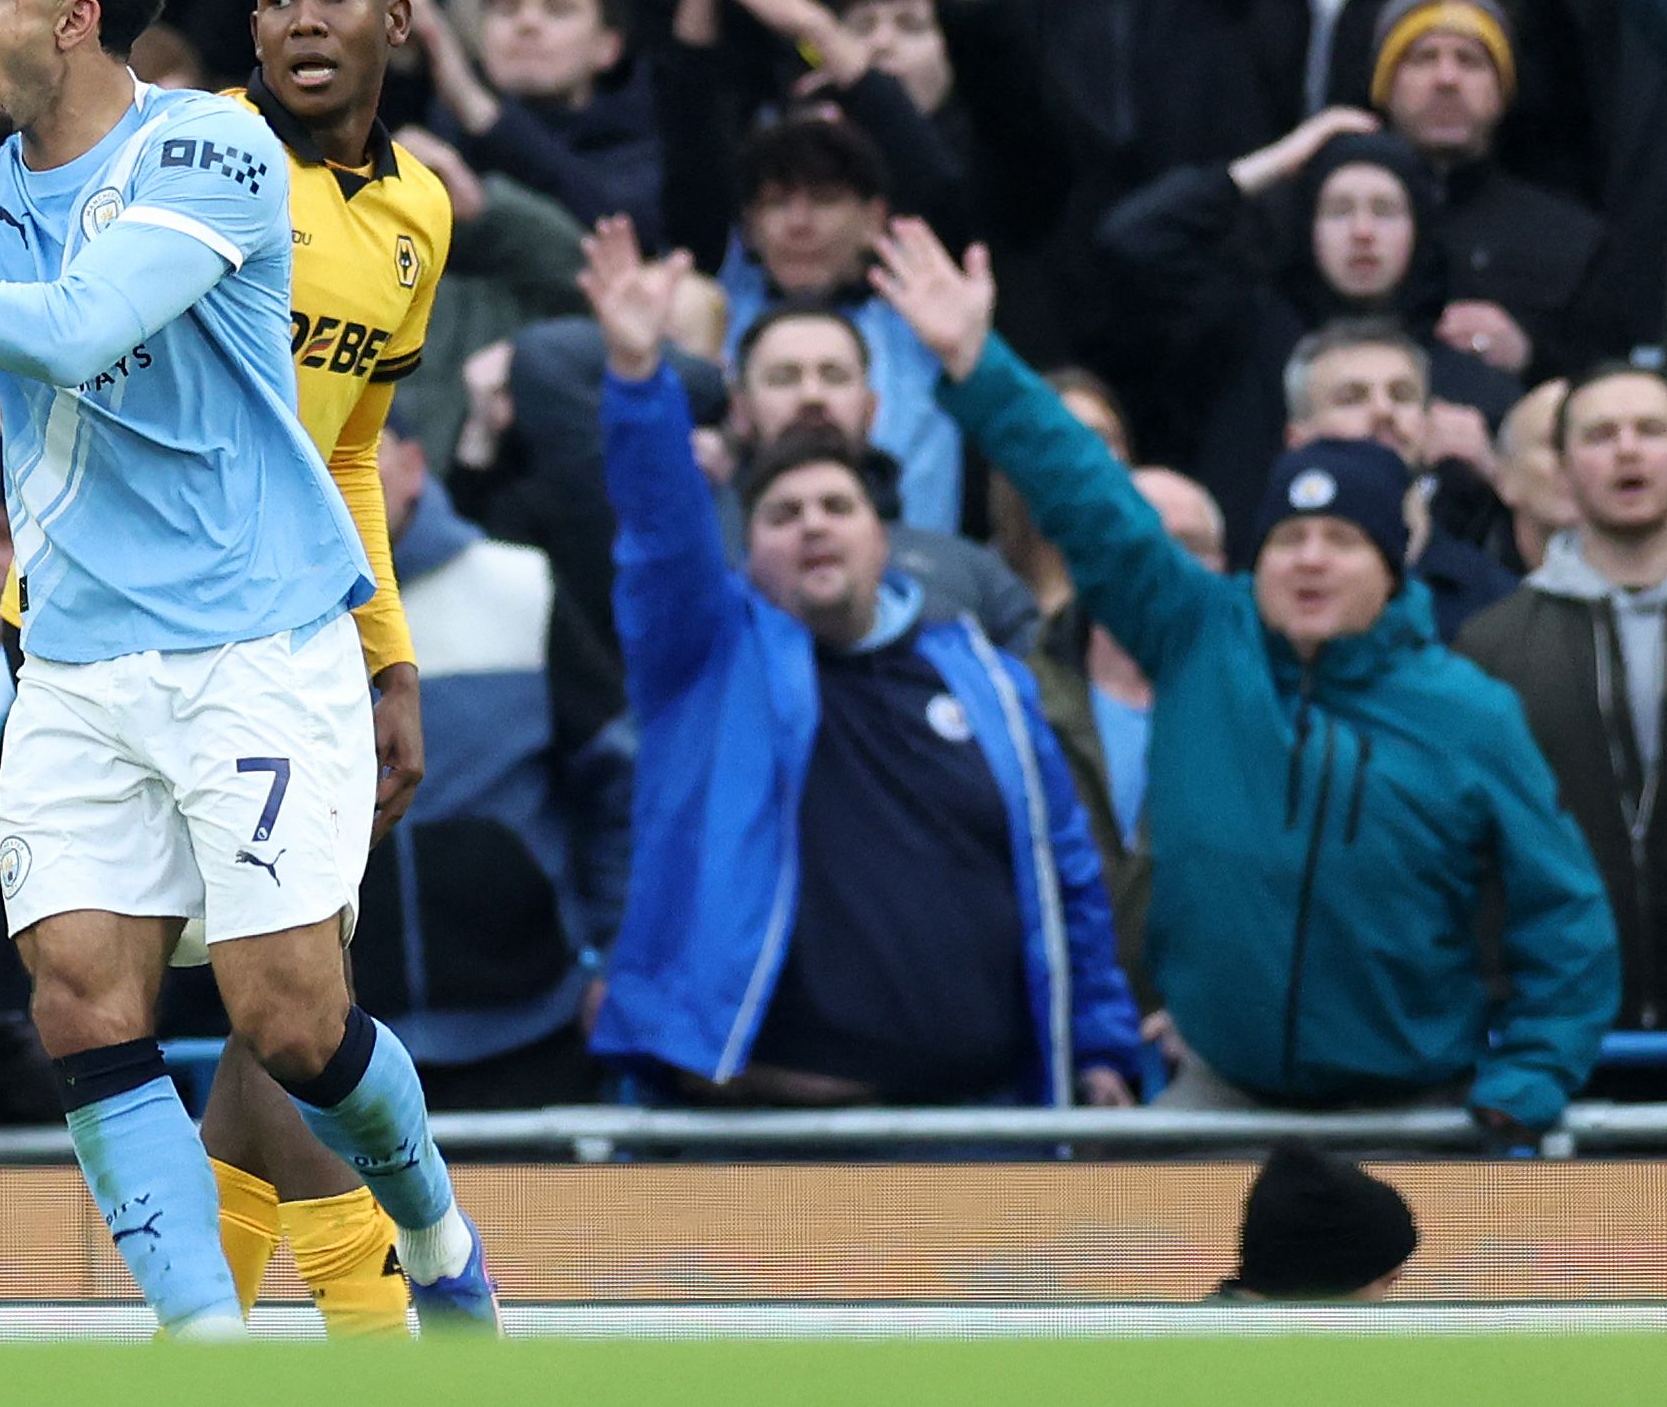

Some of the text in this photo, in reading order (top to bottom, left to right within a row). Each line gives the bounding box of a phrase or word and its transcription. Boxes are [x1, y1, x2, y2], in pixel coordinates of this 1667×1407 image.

[291, 229, 312, 246] DU
[290, 310, 393, 377] DEBE
[236, 757, 290, 842] 7
